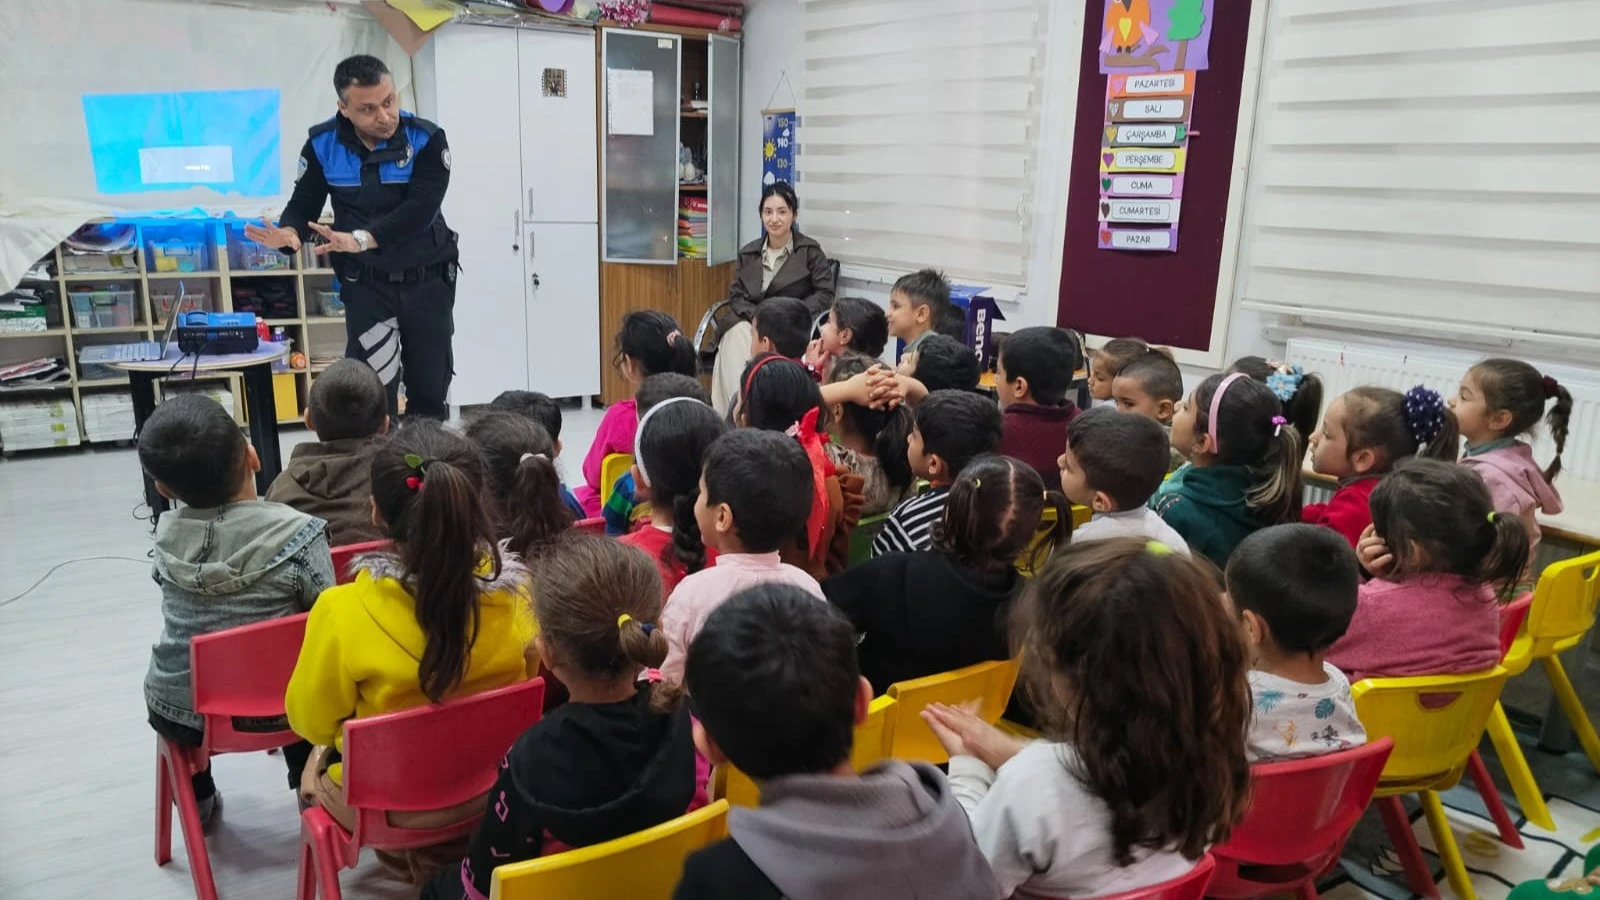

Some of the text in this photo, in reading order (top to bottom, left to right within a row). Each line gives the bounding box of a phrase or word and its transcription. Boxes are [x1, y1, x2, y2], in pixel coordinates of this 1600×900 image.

[1134, 78, 1176, 89] PAZARTESİ
[1144, 104, 1162, 113] SALI
[777, 117, 788, 127] 150
[1125, 130, 1167, 143] ÇARŞAMBA
[777, 137, 788, 148] 140
[1125, 155, 1164, 166] PERŞEMBE
[1131, 180, 1153, 190] CUMA
[1119, 205, 1161, 216] CUMARTESİ
[1126, 235, 1151, 244] PAZAR
